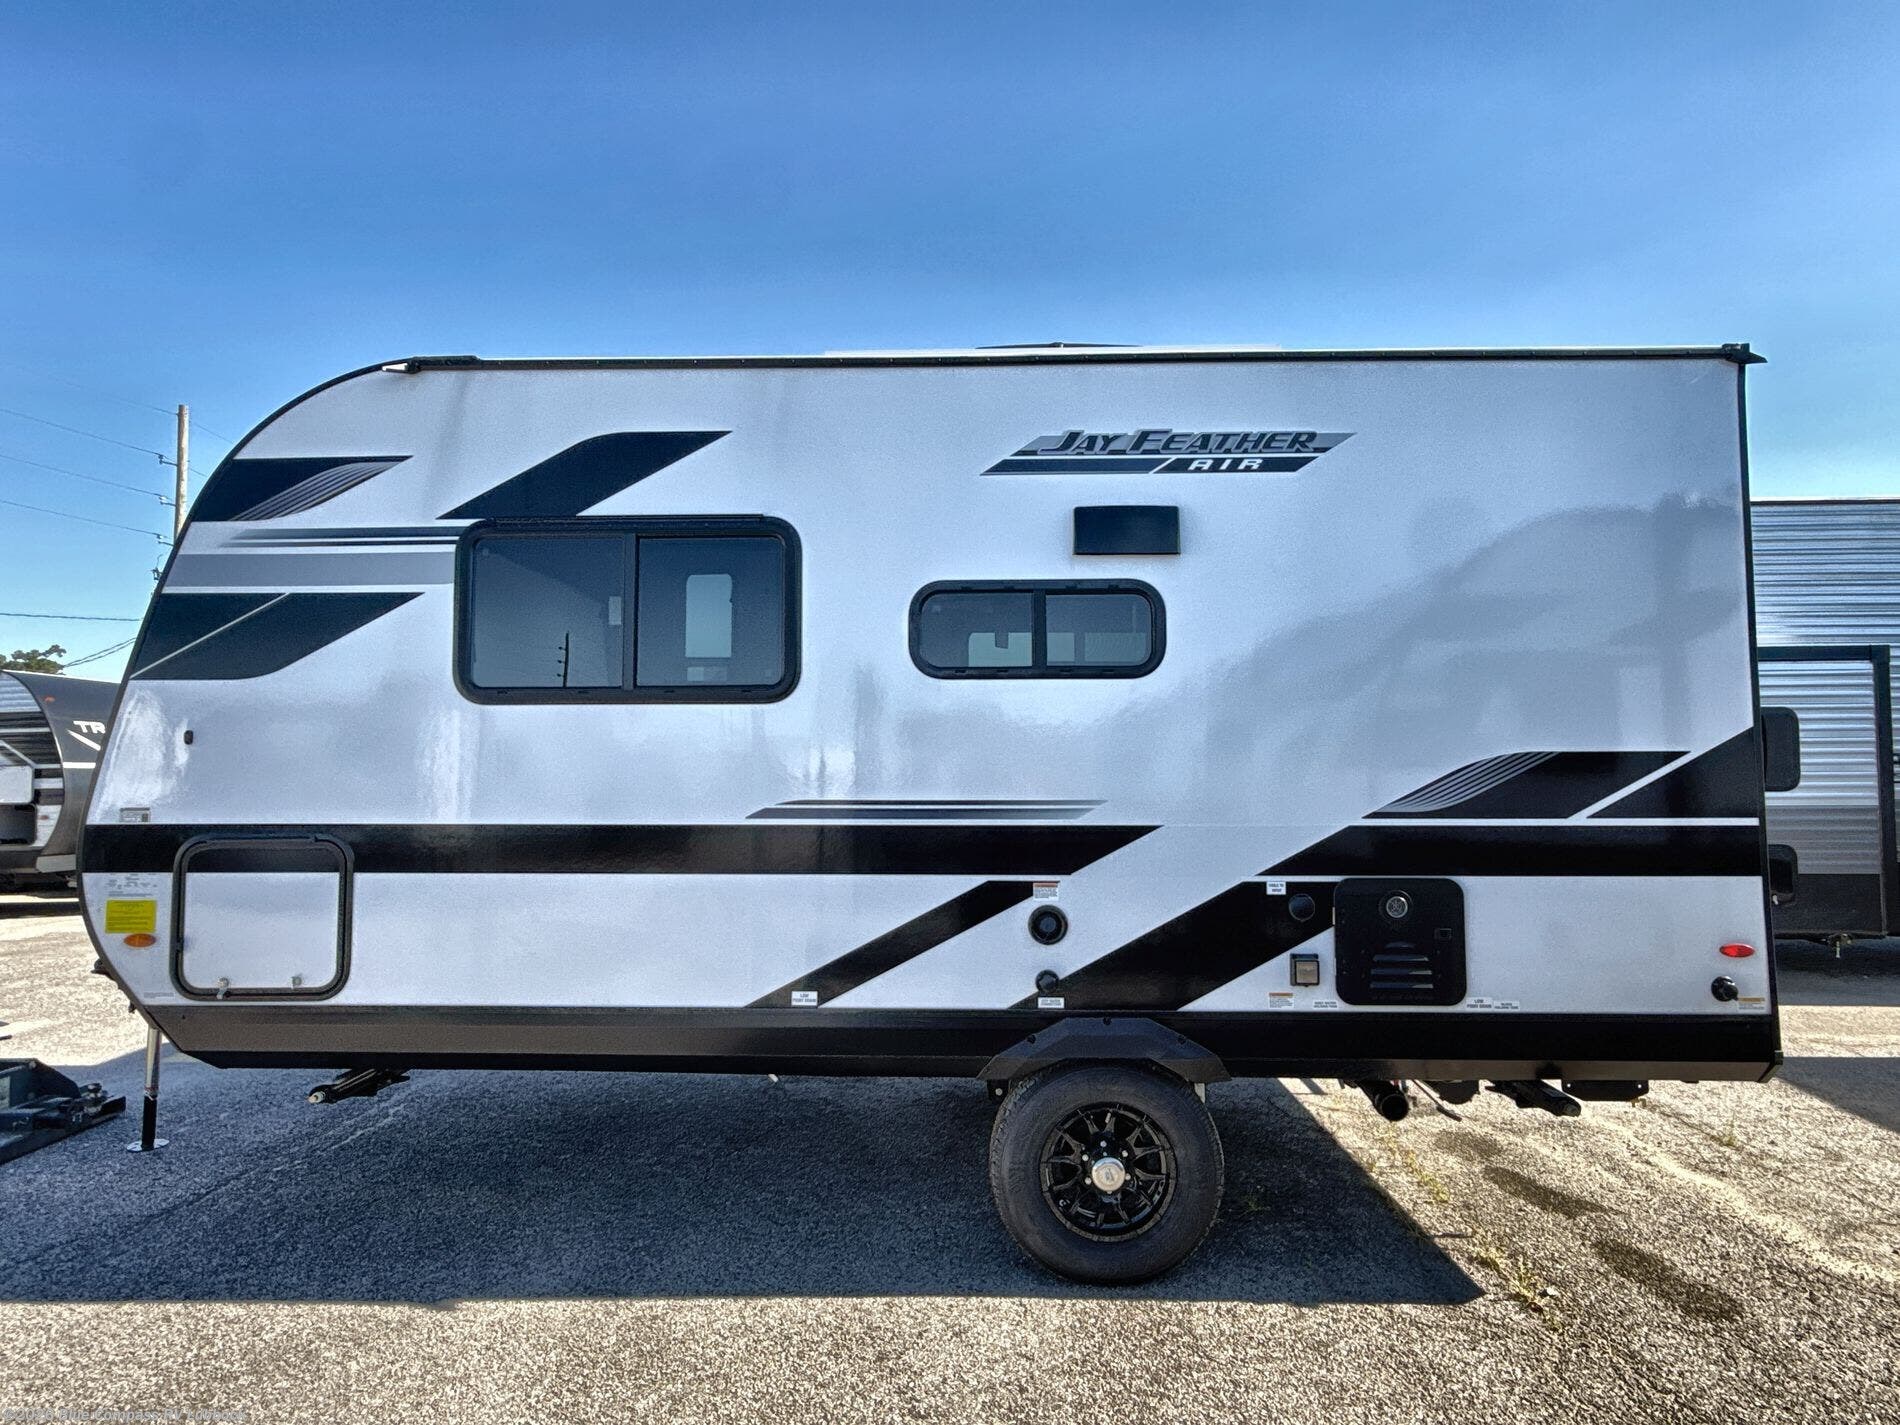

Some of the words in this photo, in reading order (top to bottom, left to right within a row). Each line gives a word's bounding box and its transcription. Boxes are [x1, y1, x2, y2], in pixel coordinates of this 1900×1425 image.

[1037, 429, 1127, 455] JAY
[1127, 428, 1320, 455] FEATHER
[1187, 458, 1265, 472] AIR
